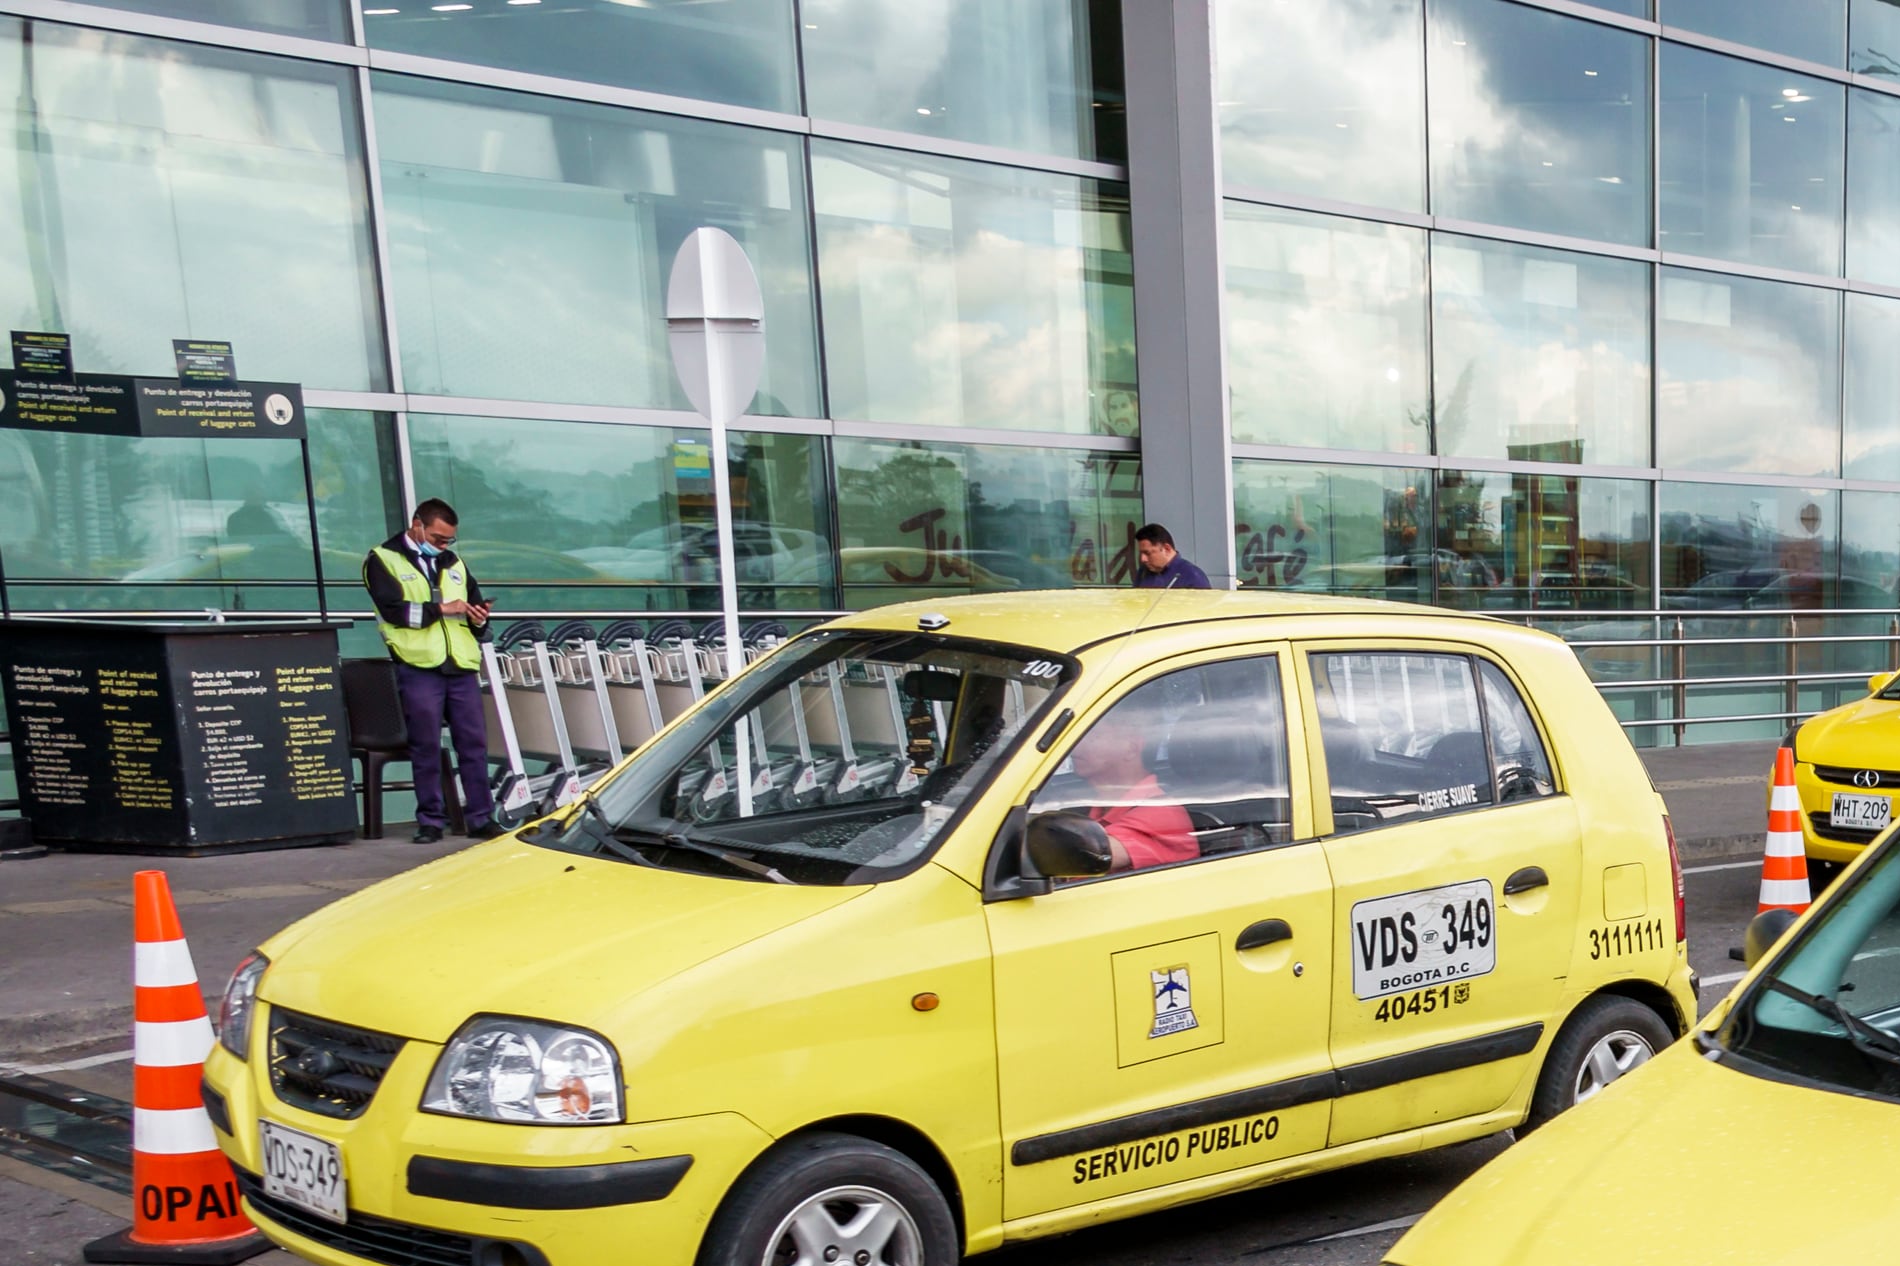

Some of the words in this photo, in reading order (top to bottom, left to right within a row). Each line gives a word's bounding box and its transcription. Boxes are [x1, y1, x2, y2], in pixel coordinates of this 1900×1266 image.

[276, 668, 295, 676] Point
[1021, 659, 1064, 679] 100
[1418, 789, 1451, 812] CIERRE
[1449, 784, 1479, 806] SUAVE
[1356, 911, 1418, 971] VDS
[1442, 898, 1491, 954] 349
[1589, 918, 1663, 960] 3111111
[1380, 968, 1442, 990] BOGOTA
[1375, 985, 1450, 1023] 40451
[1073, 1137, 1179, 1184] SERVICIO
[1187, 1116, 1279, 1158] PUBLICO
